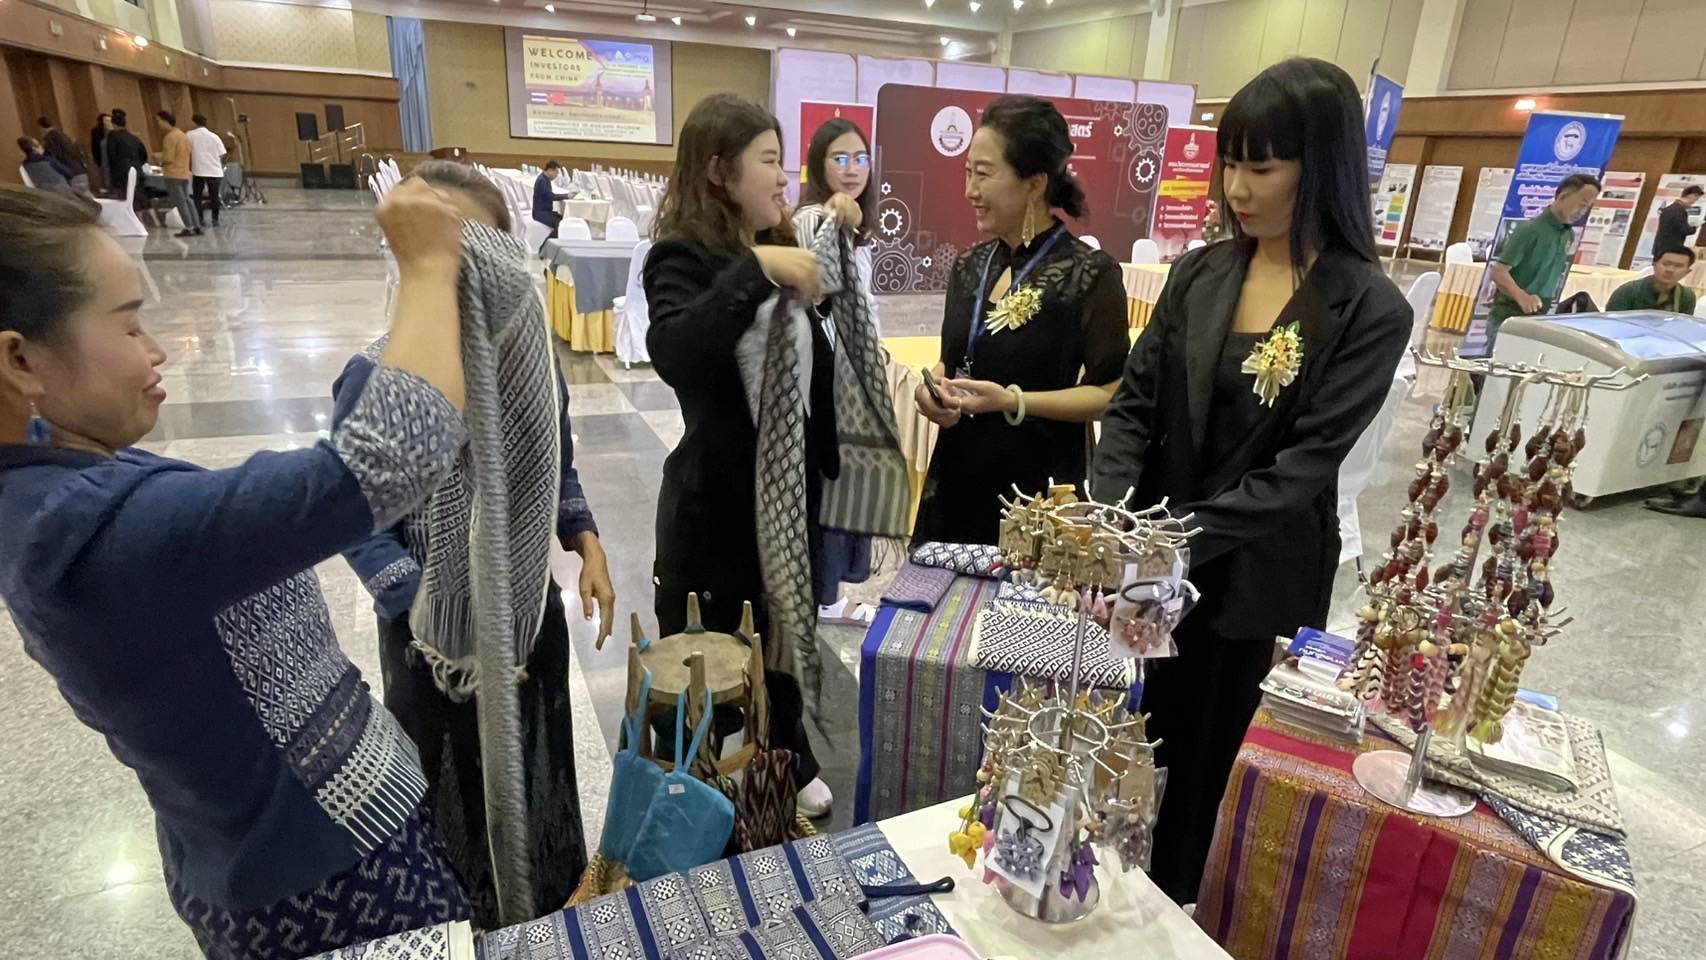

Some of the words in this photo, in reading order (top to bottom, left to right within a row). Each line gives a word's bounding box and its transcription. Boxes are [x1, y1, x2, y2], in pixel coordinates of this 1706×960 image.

[528, 47, 593, 61] WELCOME
[530, 61, 581, 72] INVESTORS
[1070, 121, 1093, 137] สตร์
